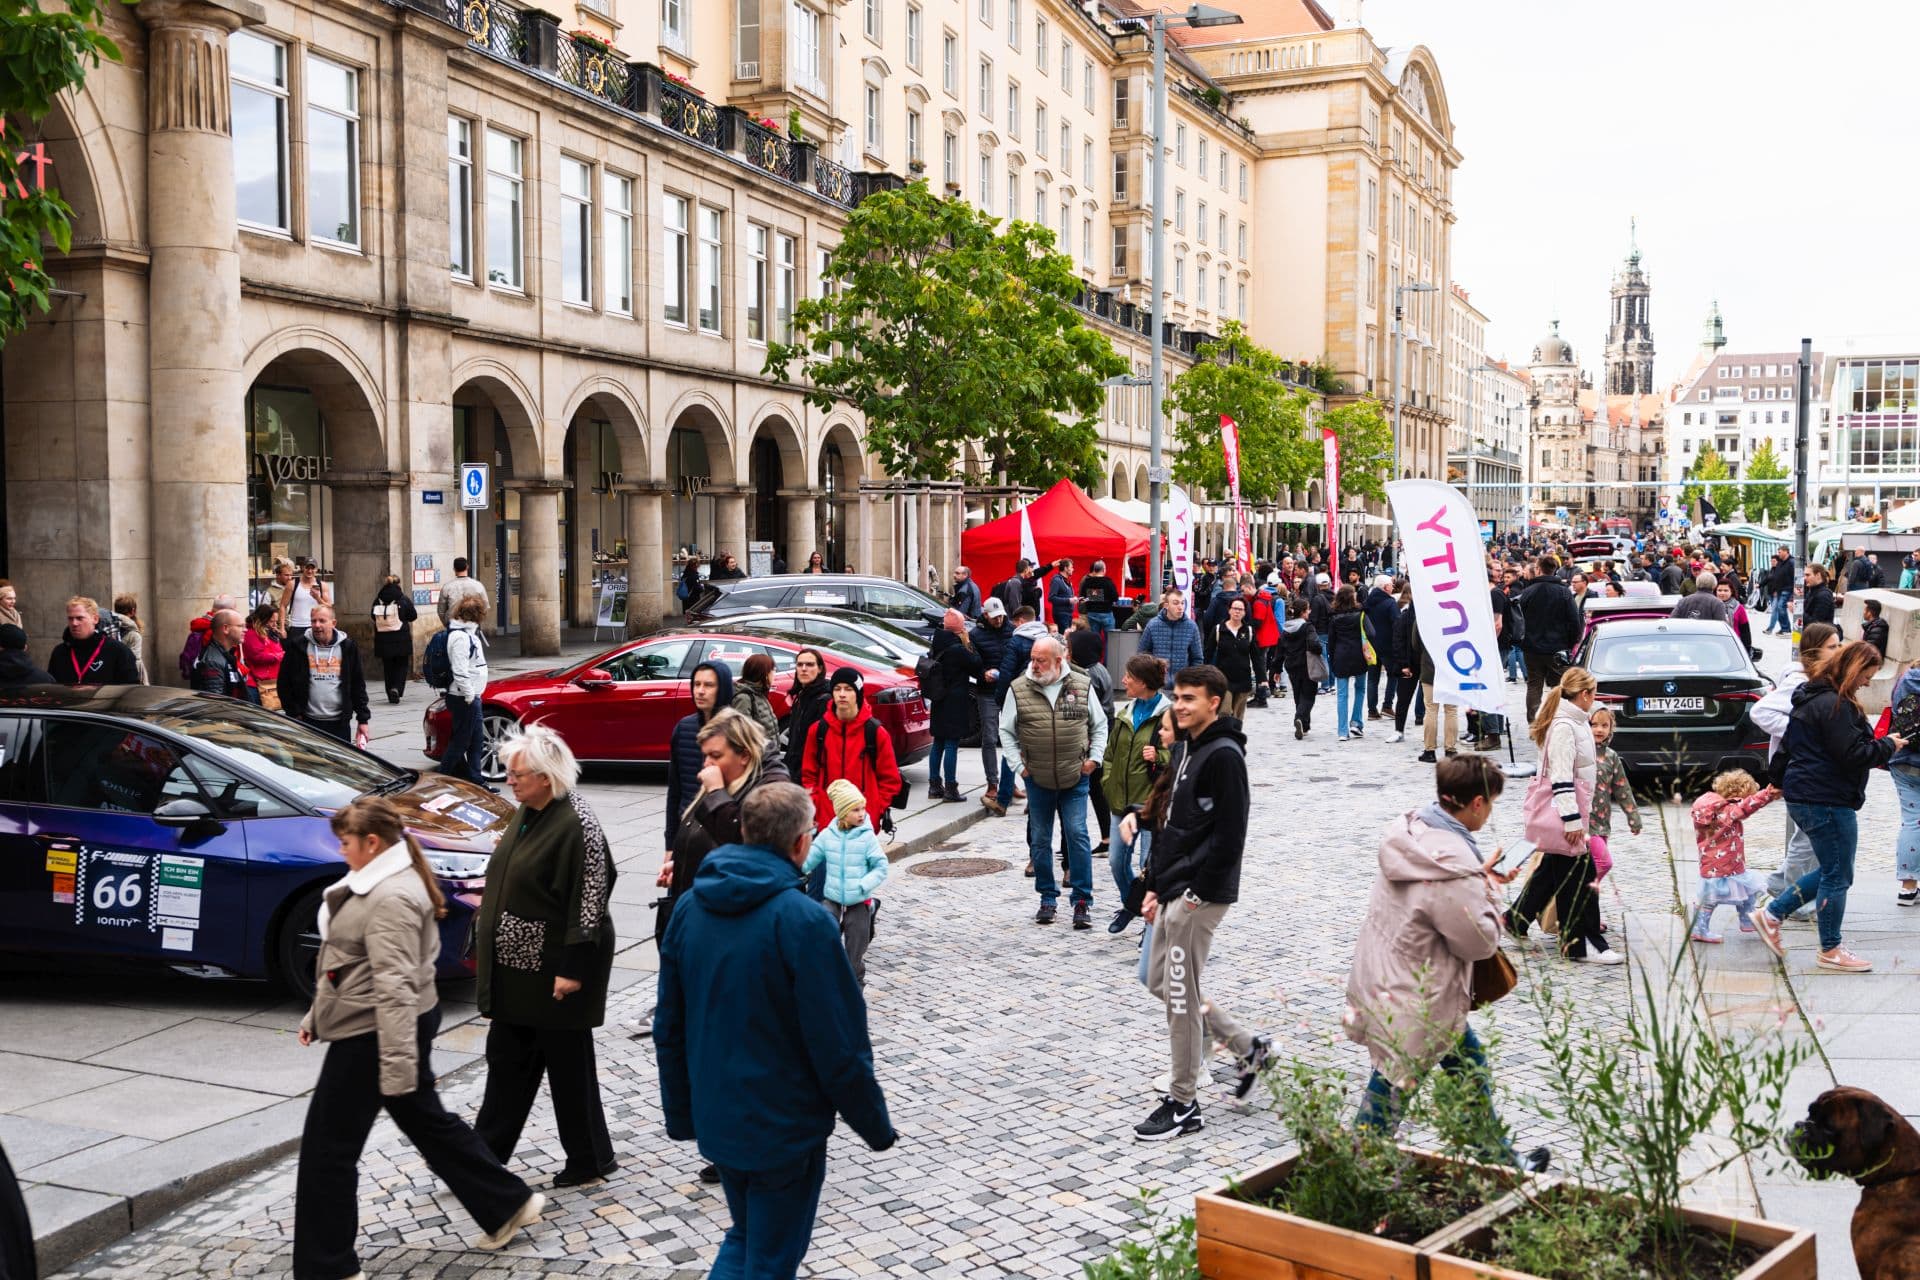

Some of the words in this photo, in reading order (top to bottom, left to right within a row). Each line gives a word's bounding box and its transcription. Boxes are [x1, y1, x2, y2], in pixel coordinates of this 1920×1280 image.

[468, 496, 481, 504] ZONE
[1657, 698, 1671, 708] TY
[93, 873, 142, 909] 66
[1169, 945, 1187, 1014] HUGO
